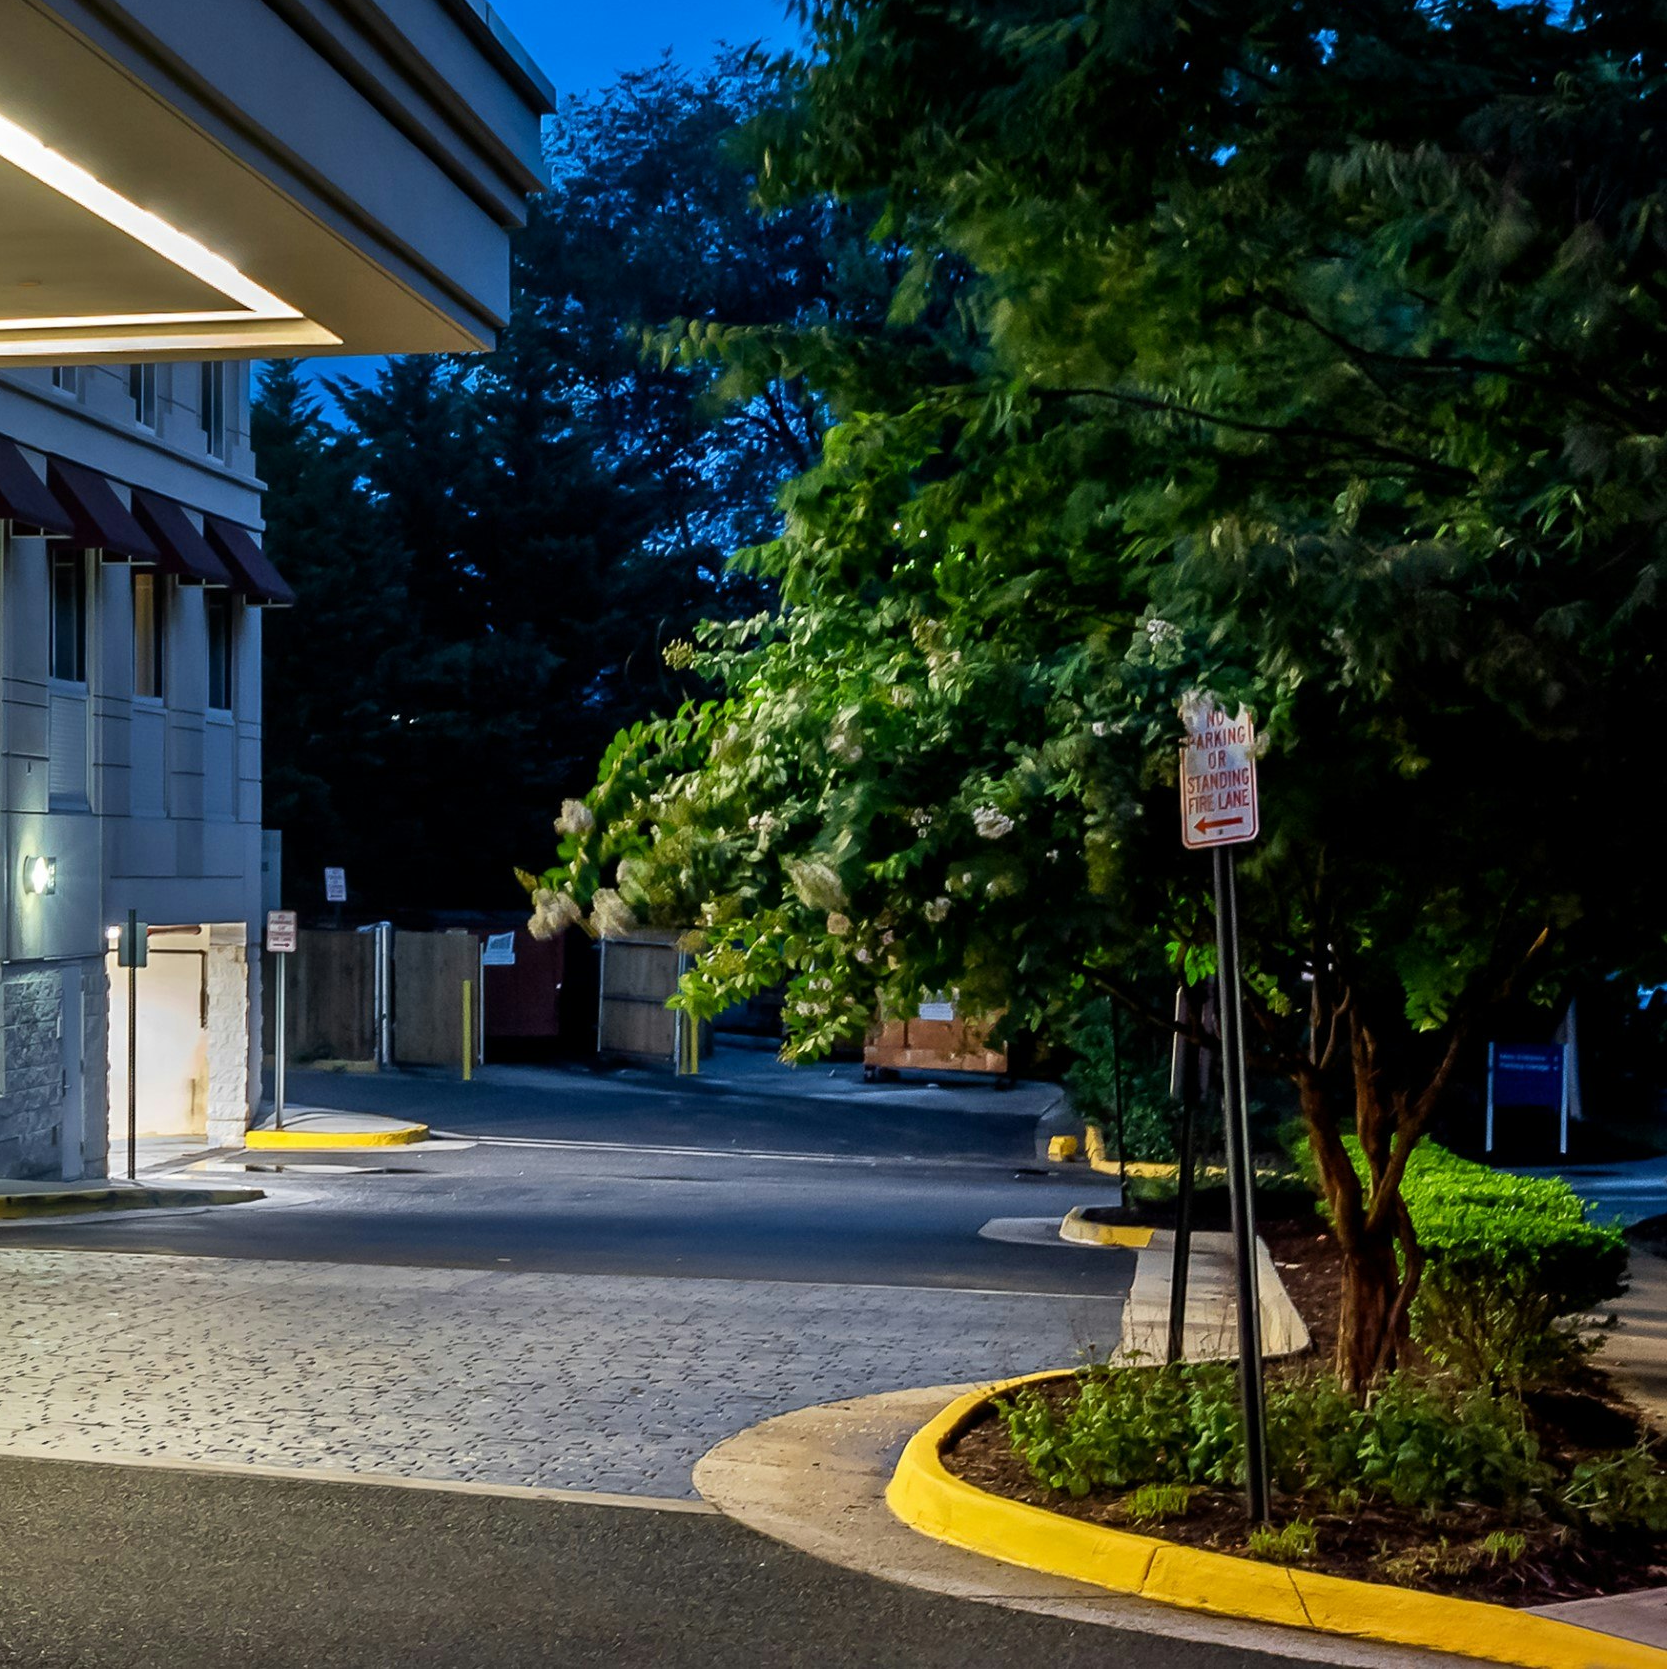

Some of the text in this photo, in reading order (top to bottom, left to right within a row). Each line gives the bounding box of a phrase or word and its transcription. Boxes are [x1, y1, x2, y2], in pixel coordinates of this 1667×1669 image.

[1207, 710, 1224, 728] NO
[1187, 725, 1245, 750] PARKING
[1208, 749, 1226, 769] OR
[1187, 767, 1250, 794] STANDING
[1188, 788, 1250, 815] FIRE LANE
